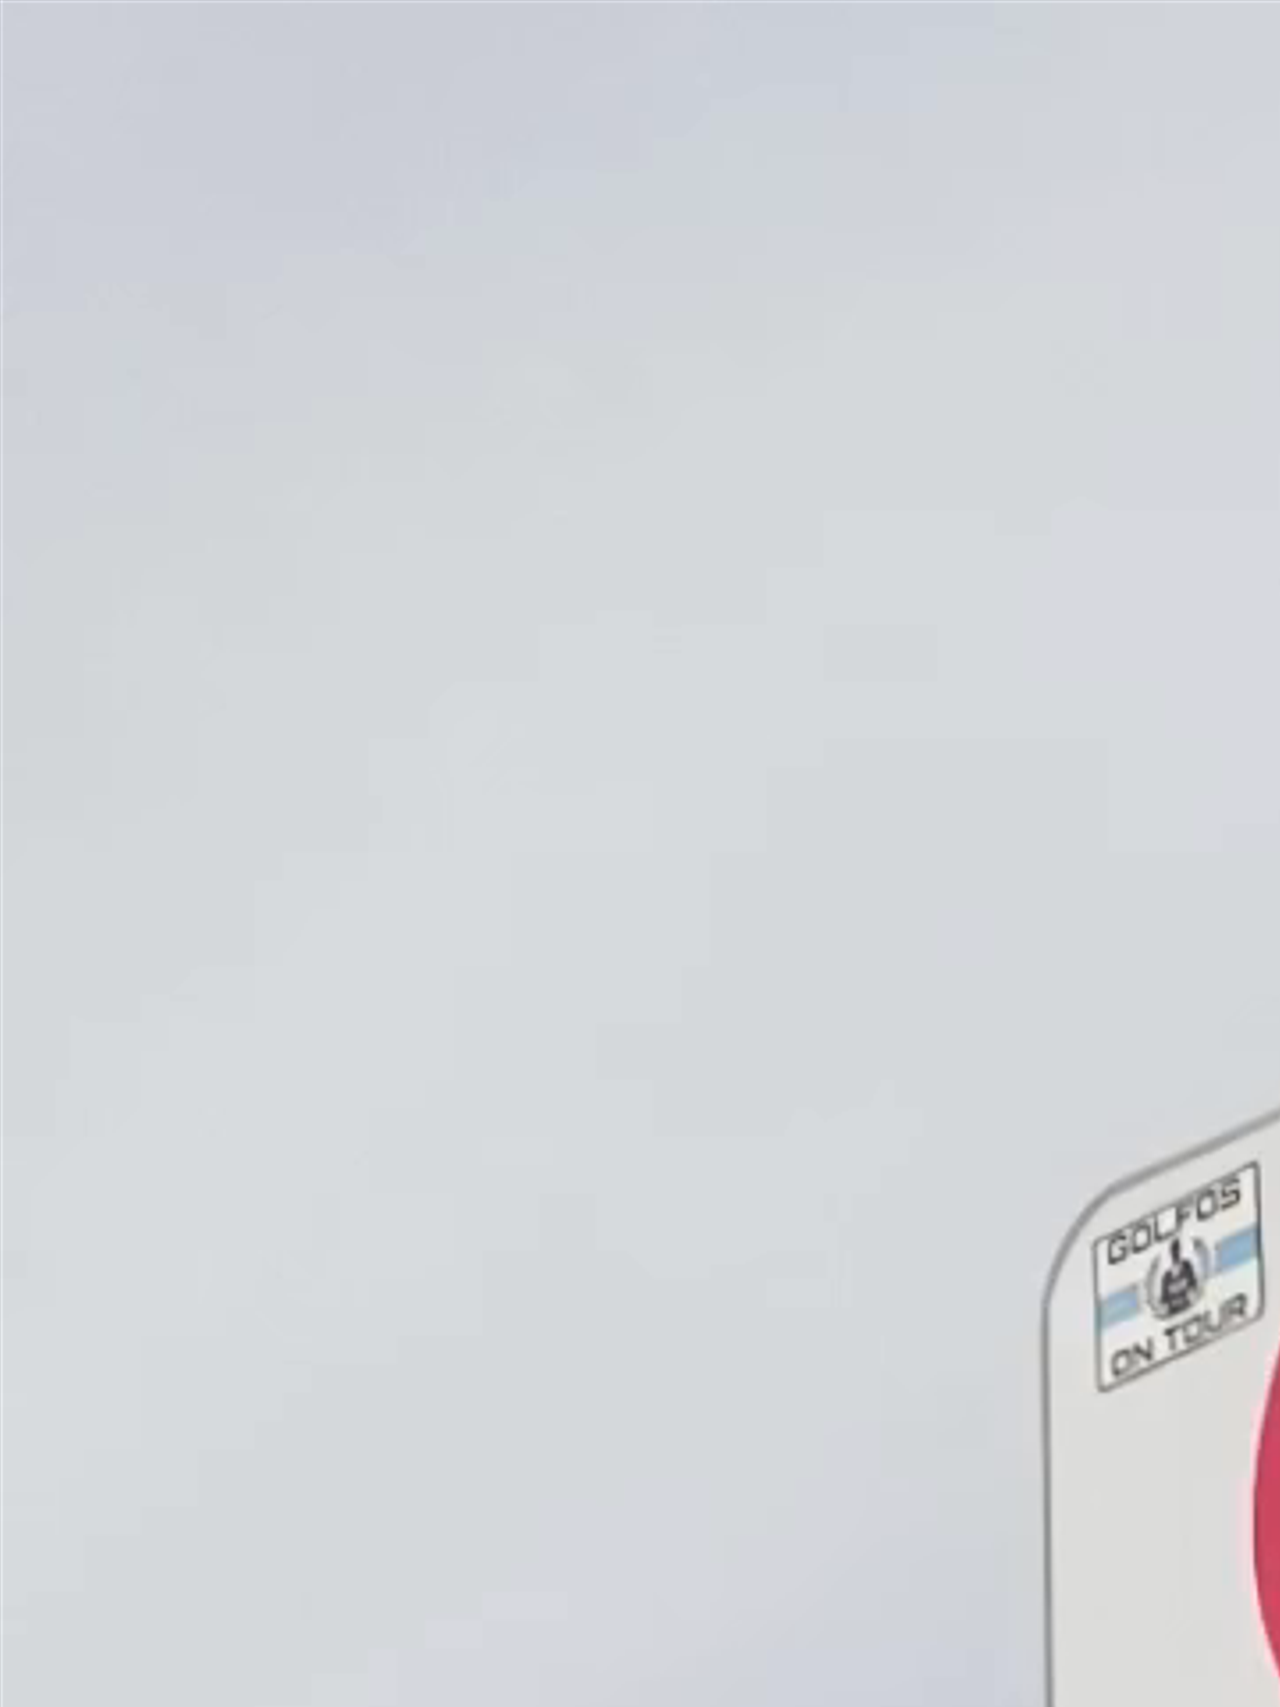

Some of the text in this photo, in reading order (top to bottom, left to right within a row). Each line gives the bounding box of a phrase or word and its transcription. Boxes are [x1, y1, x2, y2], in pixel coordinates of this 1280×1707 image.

[1109, 1173, 1240, 1264] GOLFOS
[1111, 1294, 1248, 1376] ON TOUR
